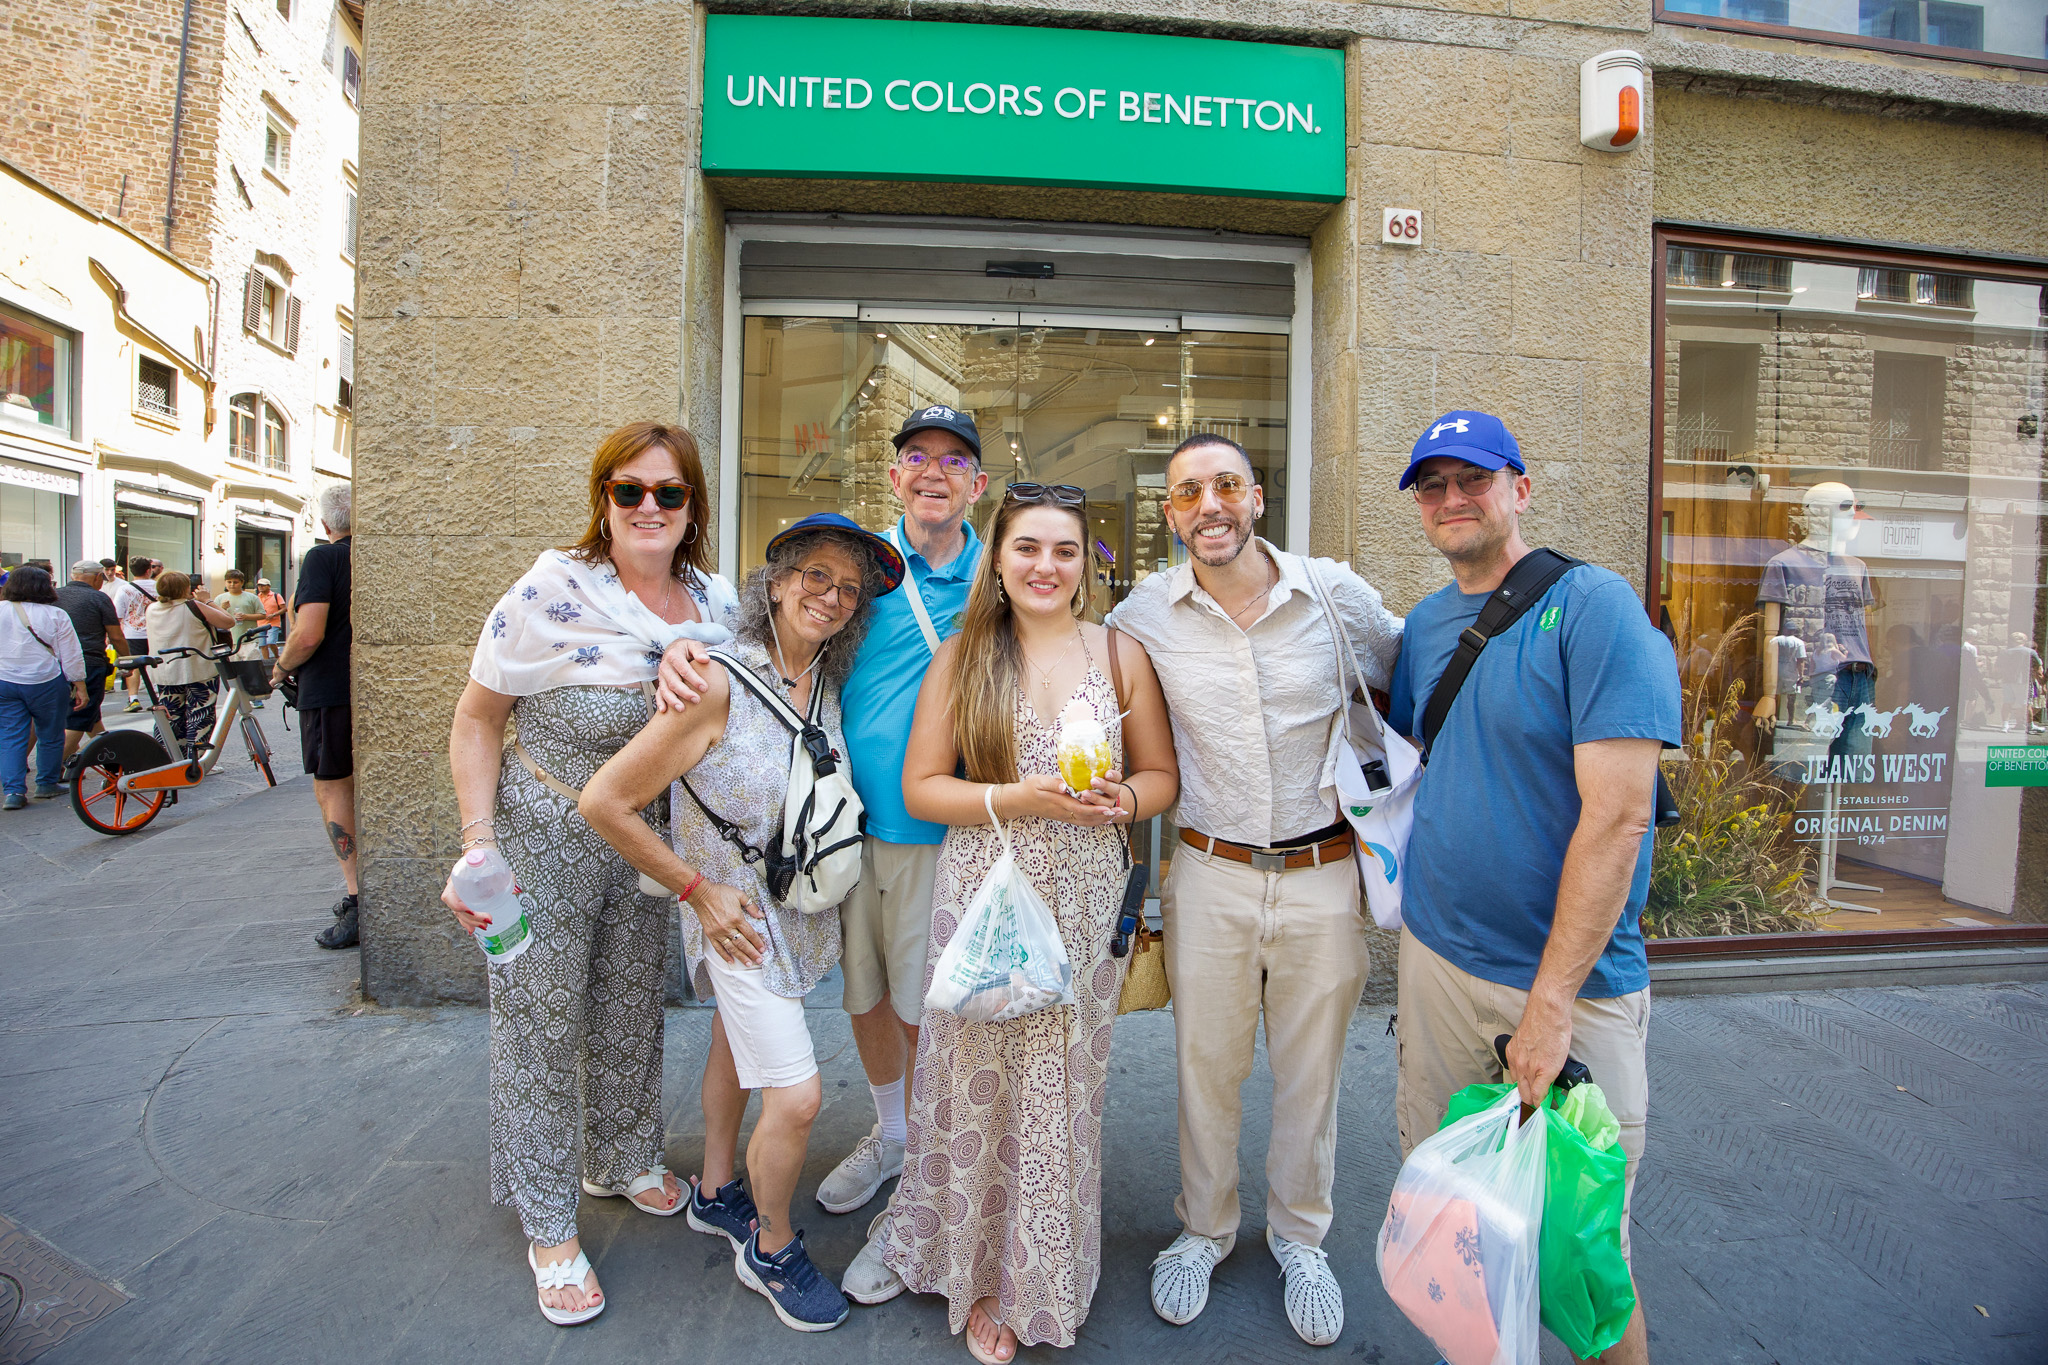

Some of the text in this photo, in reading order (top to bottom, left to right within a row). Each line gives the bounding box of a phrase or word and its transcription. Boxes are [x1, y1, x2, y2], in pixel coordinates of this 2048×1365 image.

[727, 75, 1322, 135] UNITED COLORS OF BENETTON.
[1389, 214, 1419, 239] 68
[1990, 748, 2048, 759] UNITED COL
[1801, 753, 1947, 784] JEAN'S WEST
[1989, 761, 2003, 771] OF
[1837, 796, 1910, 805] ESTABLISHED
[1794, 815, 1947, 835] ORIGINAL DENIM
[1858, 835, 1886, 846] 1974
